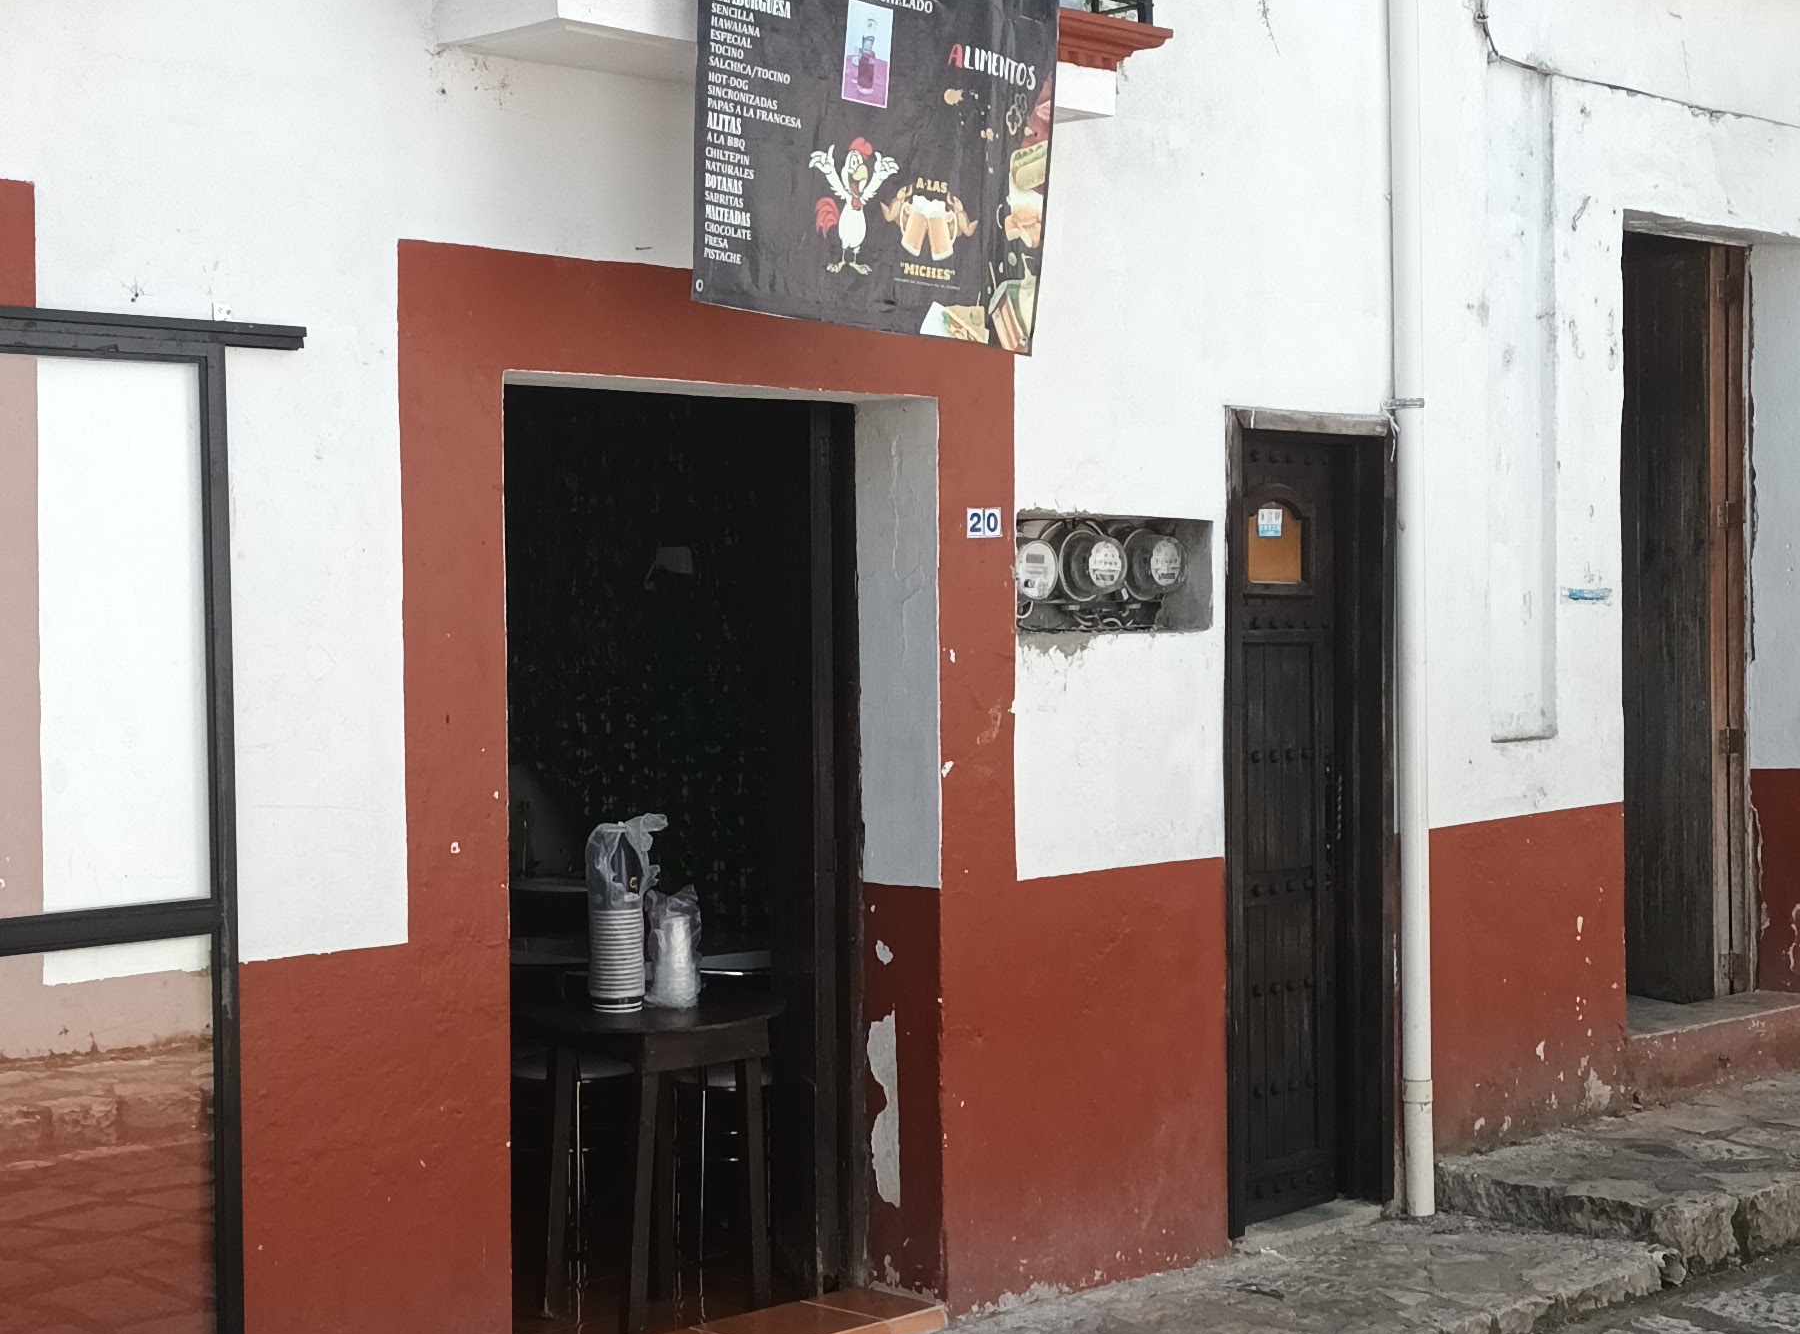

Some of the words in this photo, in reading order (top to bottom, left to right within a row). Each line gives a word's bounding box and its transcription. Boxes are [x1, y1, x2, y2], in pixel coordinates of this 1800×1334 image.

[711, 2, 754, 23] SENCILLA
[711, 15, 760, 37] HAWAIANA
[711, 29, 752, 48] ESPECIAL
[710, 42, 744, 59] TOCINO
[708, 56, 790, 84] SALCHICA/TOCINO
[948, 44, 1036, 90] ALIMENTOS
[708, 85, 778, 110] SINCRONIZADAS
[707, 111, 742, 135] ALITAS
[708, 98, 734, 113] PAPAS
[735, 105, 741, 116] A
[743, 106, 754, 118] LA
[756, 109, 801, 129] FRANCESA
[706, 132, 712, 142] A
[714, 133, 725, 145] LA
[727, 135, 745, 151] BBQ
[705, 147, 749, 166] CHILTEPIN
[705, 160, 754, 180] NATURALES
[705, 173, 742, 195] BOTANAS
[705, 191, 744, 208] SABRITAS
[705, 204, 750, 227] MALTEADAS
[705, 221, 752, 240] CHOCOLATE
[705, 234, 728, 249] FRESA
[704, 247, 741, 264] PISTACHE
